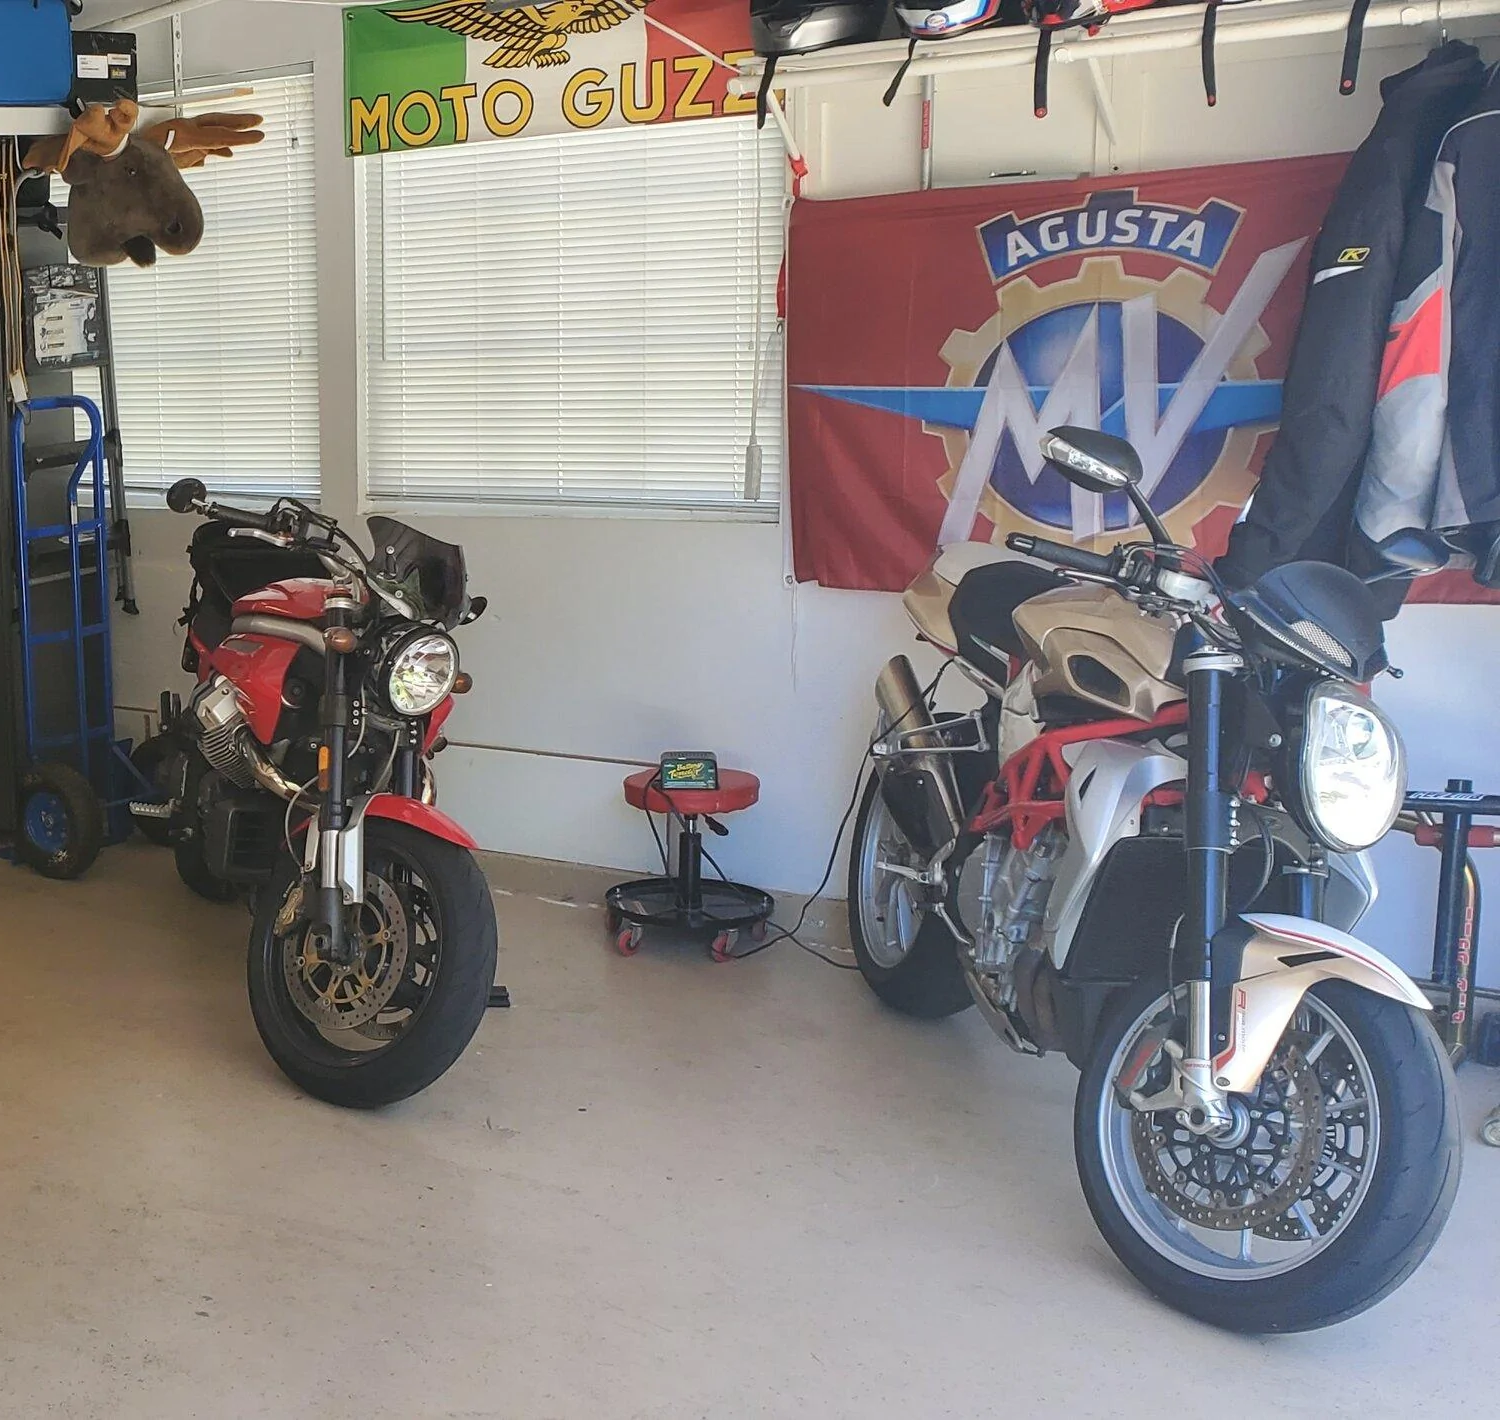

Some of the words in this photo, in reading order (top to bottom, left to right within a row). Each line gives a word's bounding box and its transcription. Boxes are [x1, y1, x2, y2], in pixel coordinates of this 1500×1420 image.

[351, 79, 534, 154] MOTO
[561, 50, 786, 129] GUZZ
[1006, 208, 1206, 267] AGUSTA
[937, 236, 1310, 547] MV
